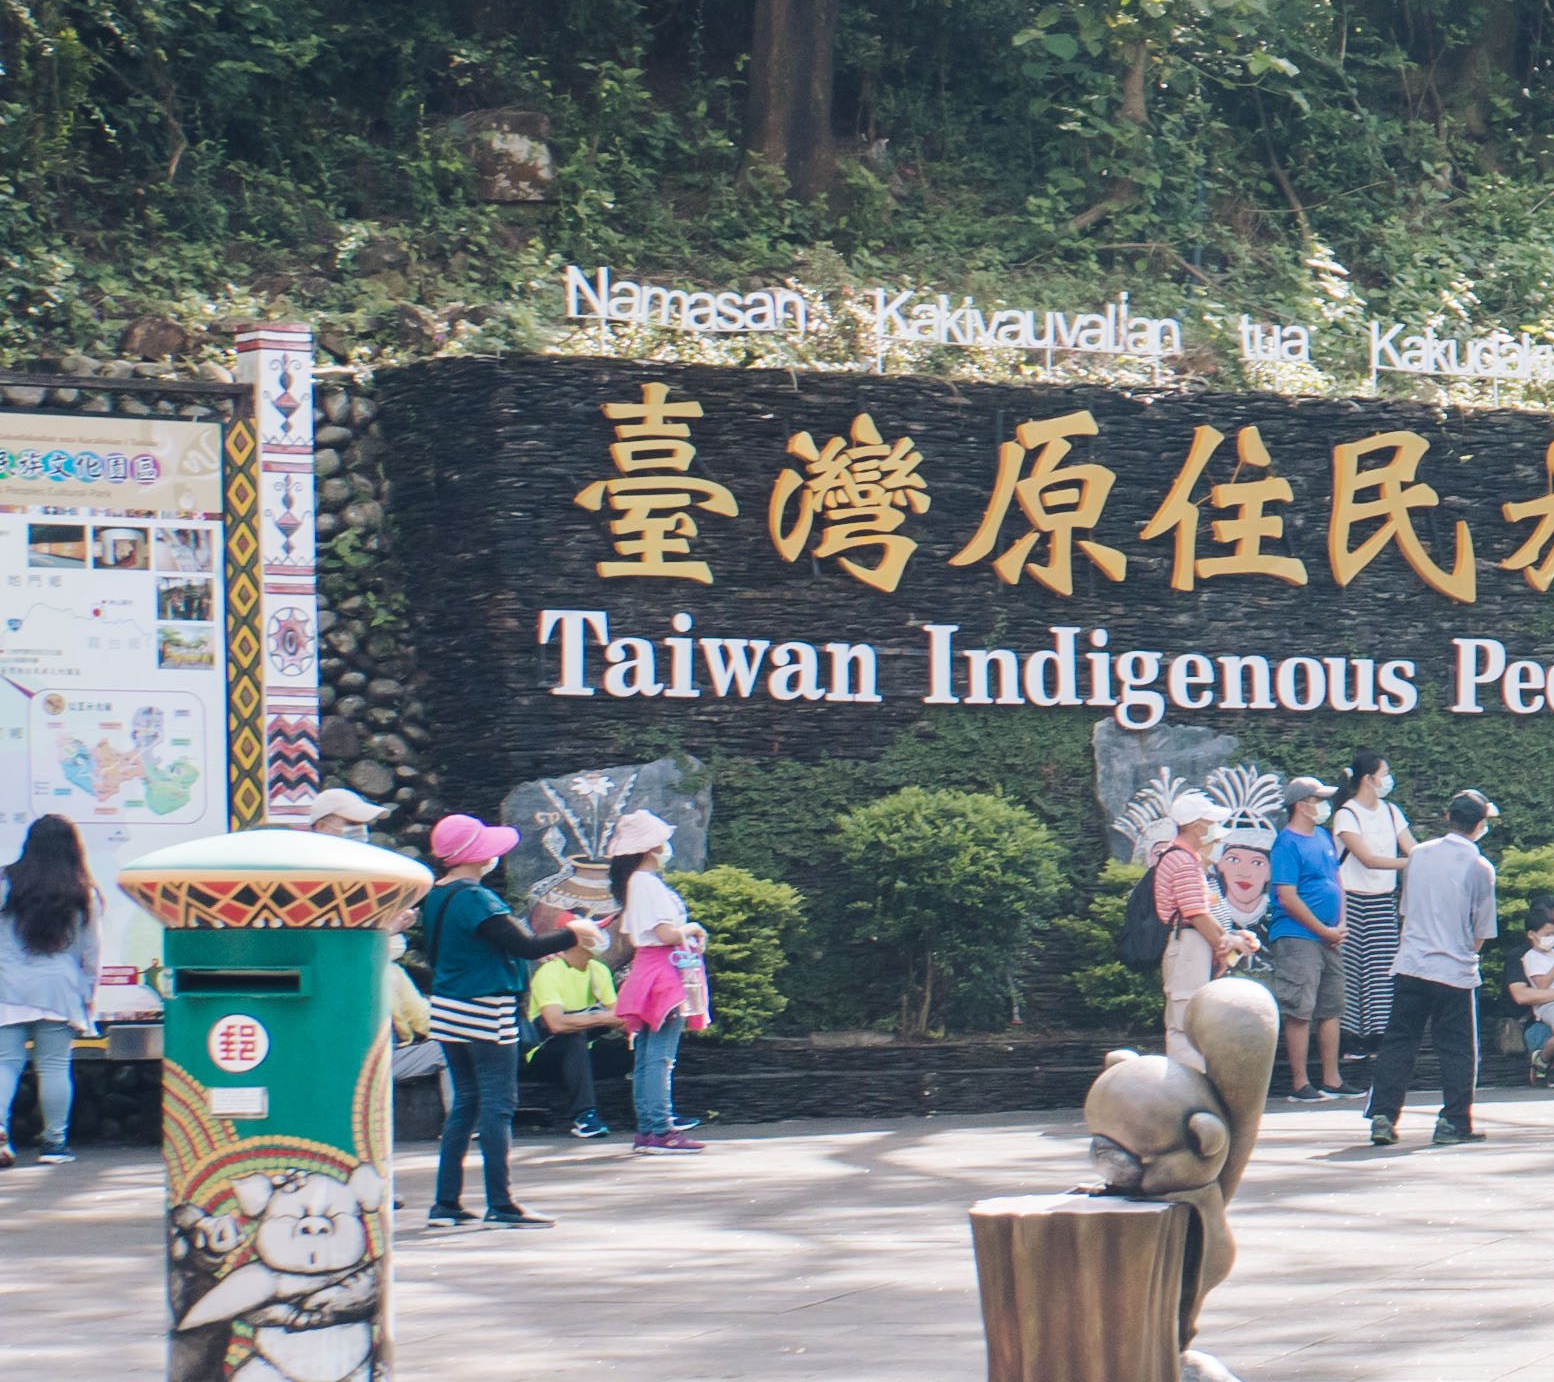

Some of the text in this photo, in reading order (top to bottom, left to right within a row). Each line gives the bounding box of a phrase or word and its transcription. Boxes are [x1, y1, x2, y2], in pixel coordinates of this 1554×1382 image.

[566, 265, 806, 335] Namasan
[1238, 313, 1310, 362] tua
[538, 609, 882, 704] Taiwan
[922, 623, 1417, 731] Indigenous
